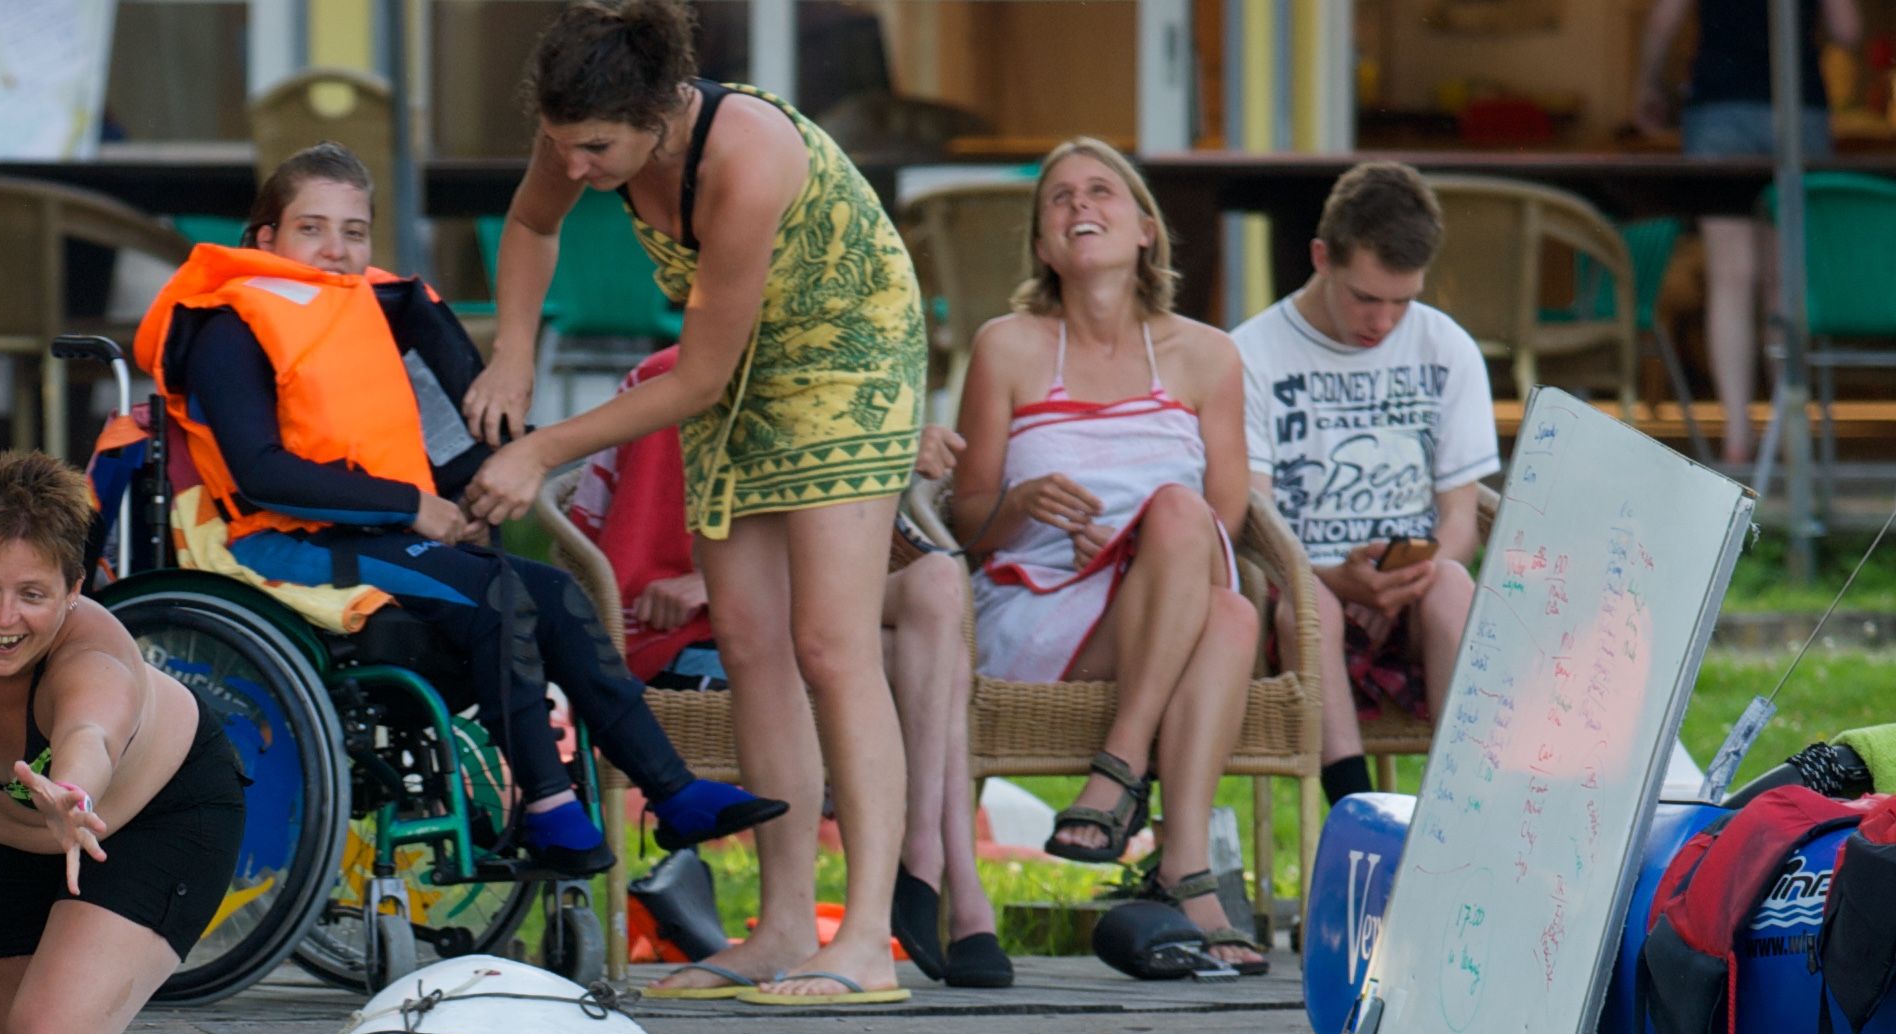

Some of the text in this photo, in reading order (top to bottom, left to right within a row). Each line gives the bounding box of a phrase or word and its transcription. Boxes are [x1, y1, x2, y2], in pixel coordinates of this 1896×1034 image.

[1309, 370, 1380, 403] CONEY
[1272, 372, 1308, 445] 54
[1305, 519, 1373, 542] NOW
